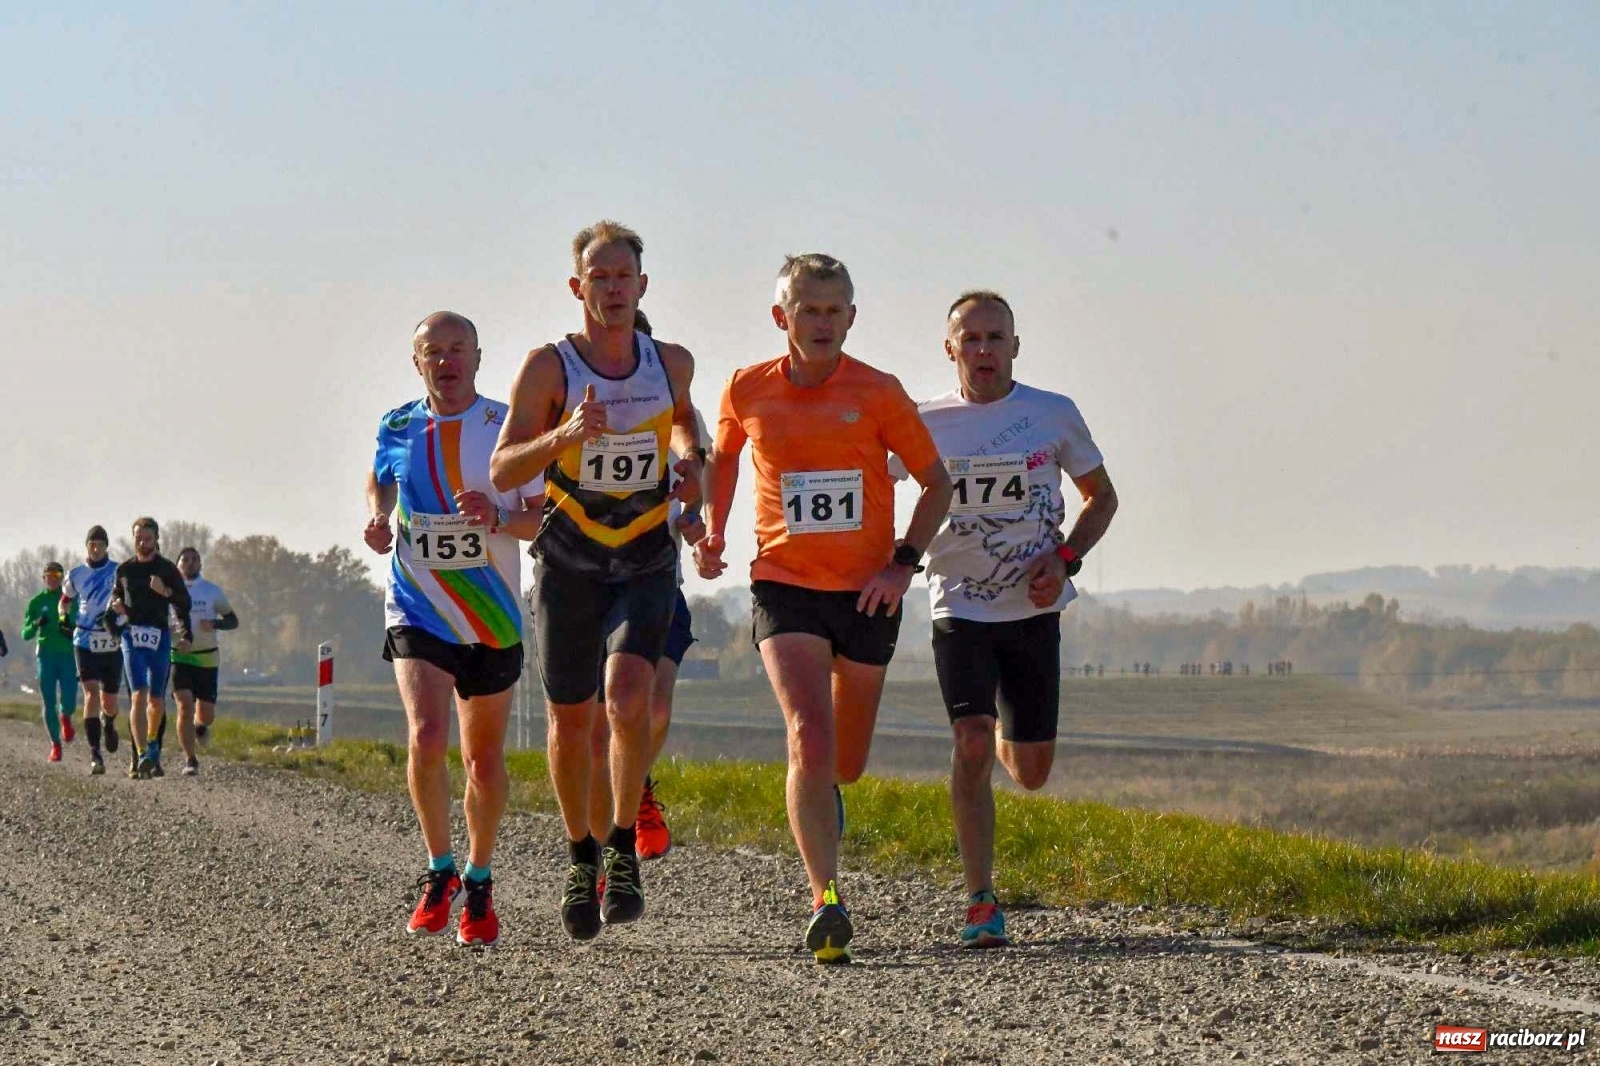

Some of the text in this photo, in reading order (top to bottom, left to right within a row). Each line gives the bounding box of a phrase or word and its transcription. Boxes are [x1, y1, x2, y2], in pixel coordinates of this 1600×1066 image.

[990, 416, 1033, 449] KIETRZ
[587, 453, 655, 482] 197
[953, 475, 1026, 505] 174
[787, 491, 854, 522] 181
[415, 532, 482, 560] 153
[92, 638, 117, 649] 173
[133, 632, 159, 645] 103
[320, 714, 328, 727] 7
